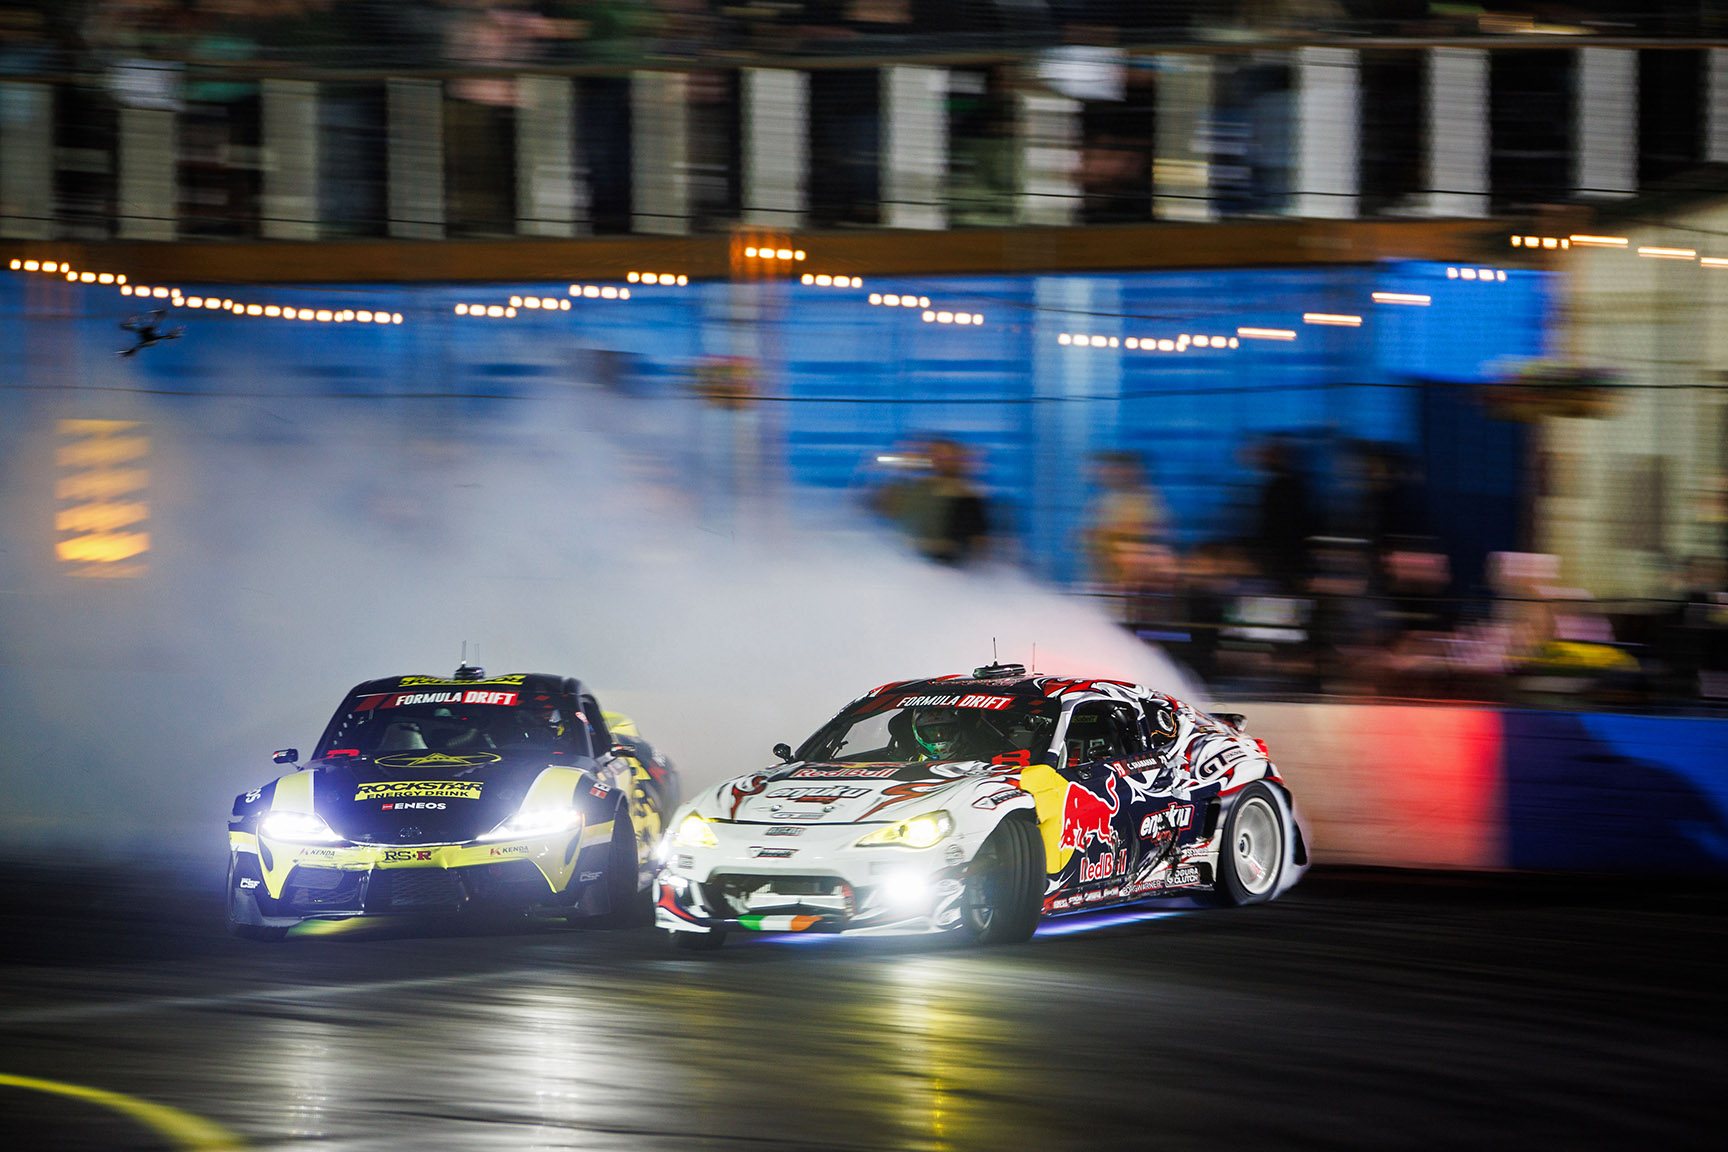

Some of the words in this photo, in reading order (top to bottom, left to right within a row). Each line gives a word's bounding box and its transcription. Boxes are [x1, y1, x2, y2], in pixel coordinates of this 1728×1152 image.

[395, 692, 462, 706] FORMULA
[464, 690, 516, 705] DRIFT
[896, 695, 961, 708] FORMULA
[958, 695, 1011, 709] DRIFT
[789, 768, 845, 778] Red
[841, 768, 899, 778] Bull
[358, 781, 482, 793] ROCKSTAR
[766, 786, 872, 800] enjuku
[367, 790, 422, 799] ENERGY
[425, 789, 468, 797] DRINK
[394, 802, 447, 810] ENEOS
[502, 846, 529, 854] KENDA
[1103, 849, 1127, 880] Bll
